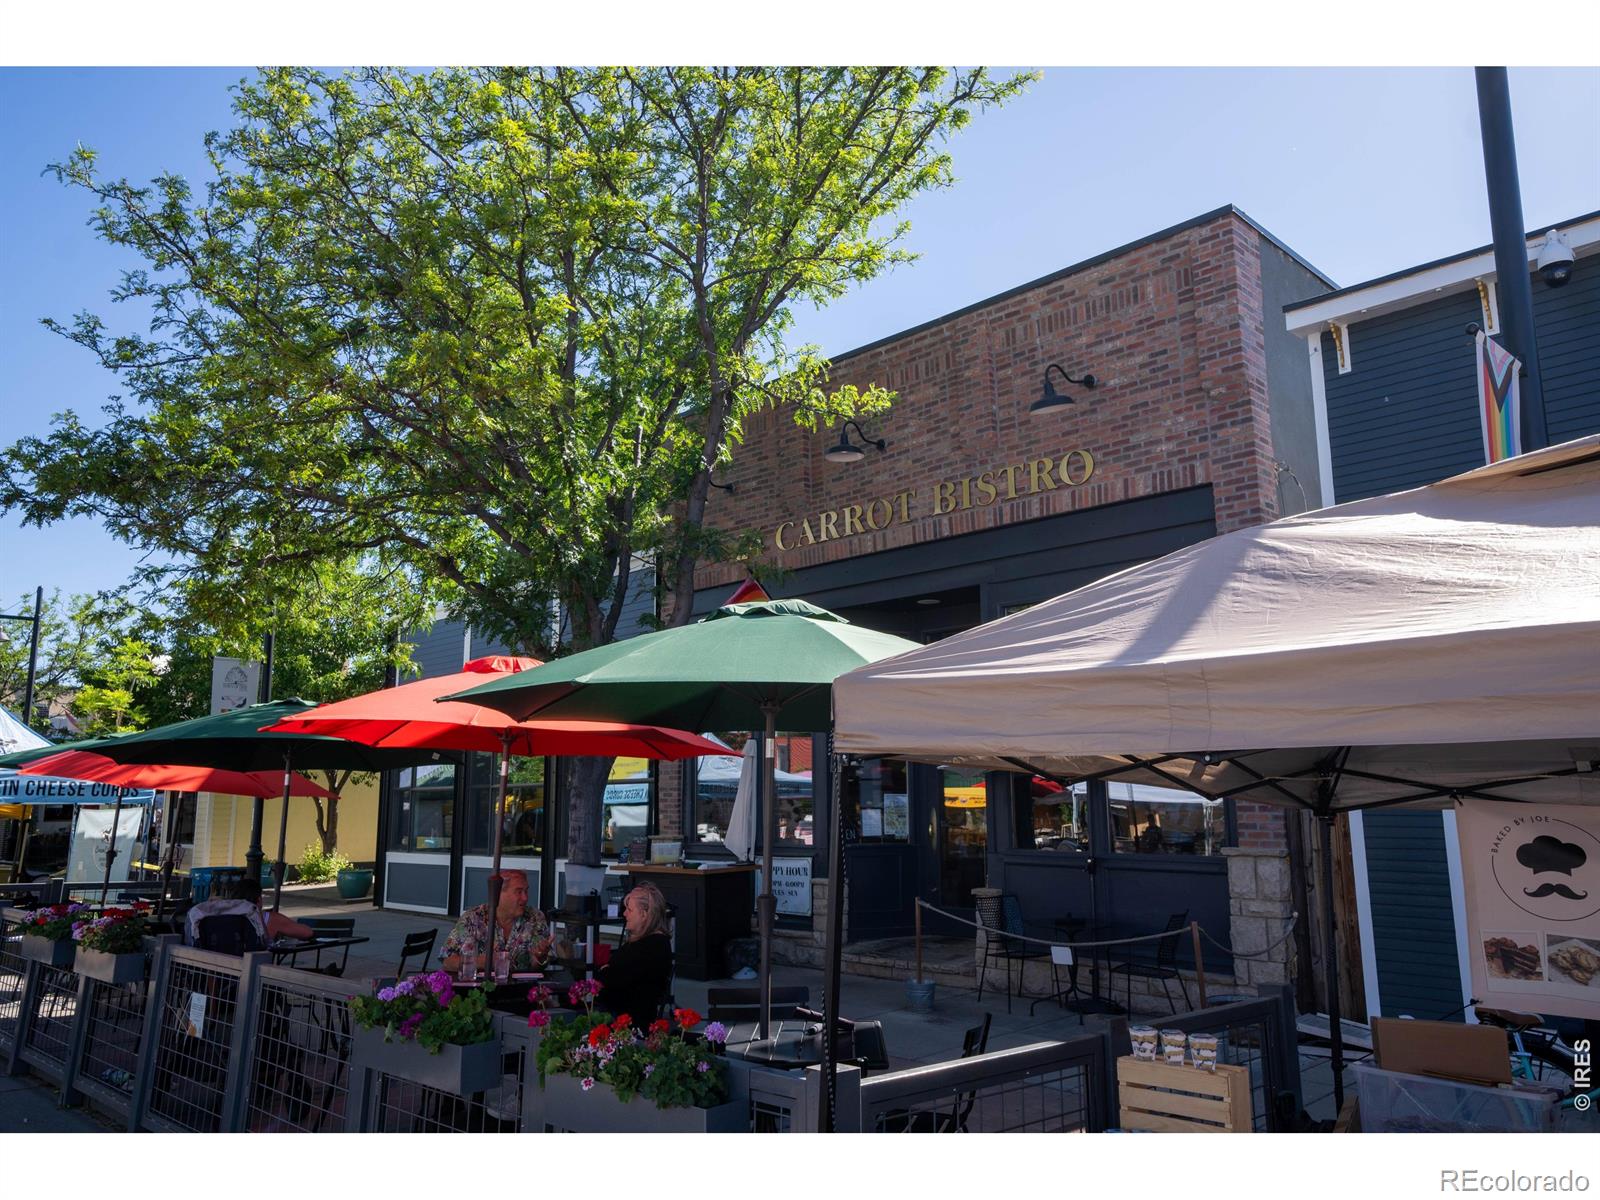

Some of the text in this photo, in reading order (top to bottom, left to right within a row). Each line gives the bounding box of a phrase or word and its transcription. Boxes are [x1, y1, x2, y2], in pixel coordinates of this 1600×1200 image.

[775, 448, 1095, 551] CARROT BISTRO
[0, 780, 19, 797] IN
[25, 780, 87, 797] CHEESE
[1491, 815, 1551, 853] BAKED BY JOE
[786, 866, 808, 877] HOUR
